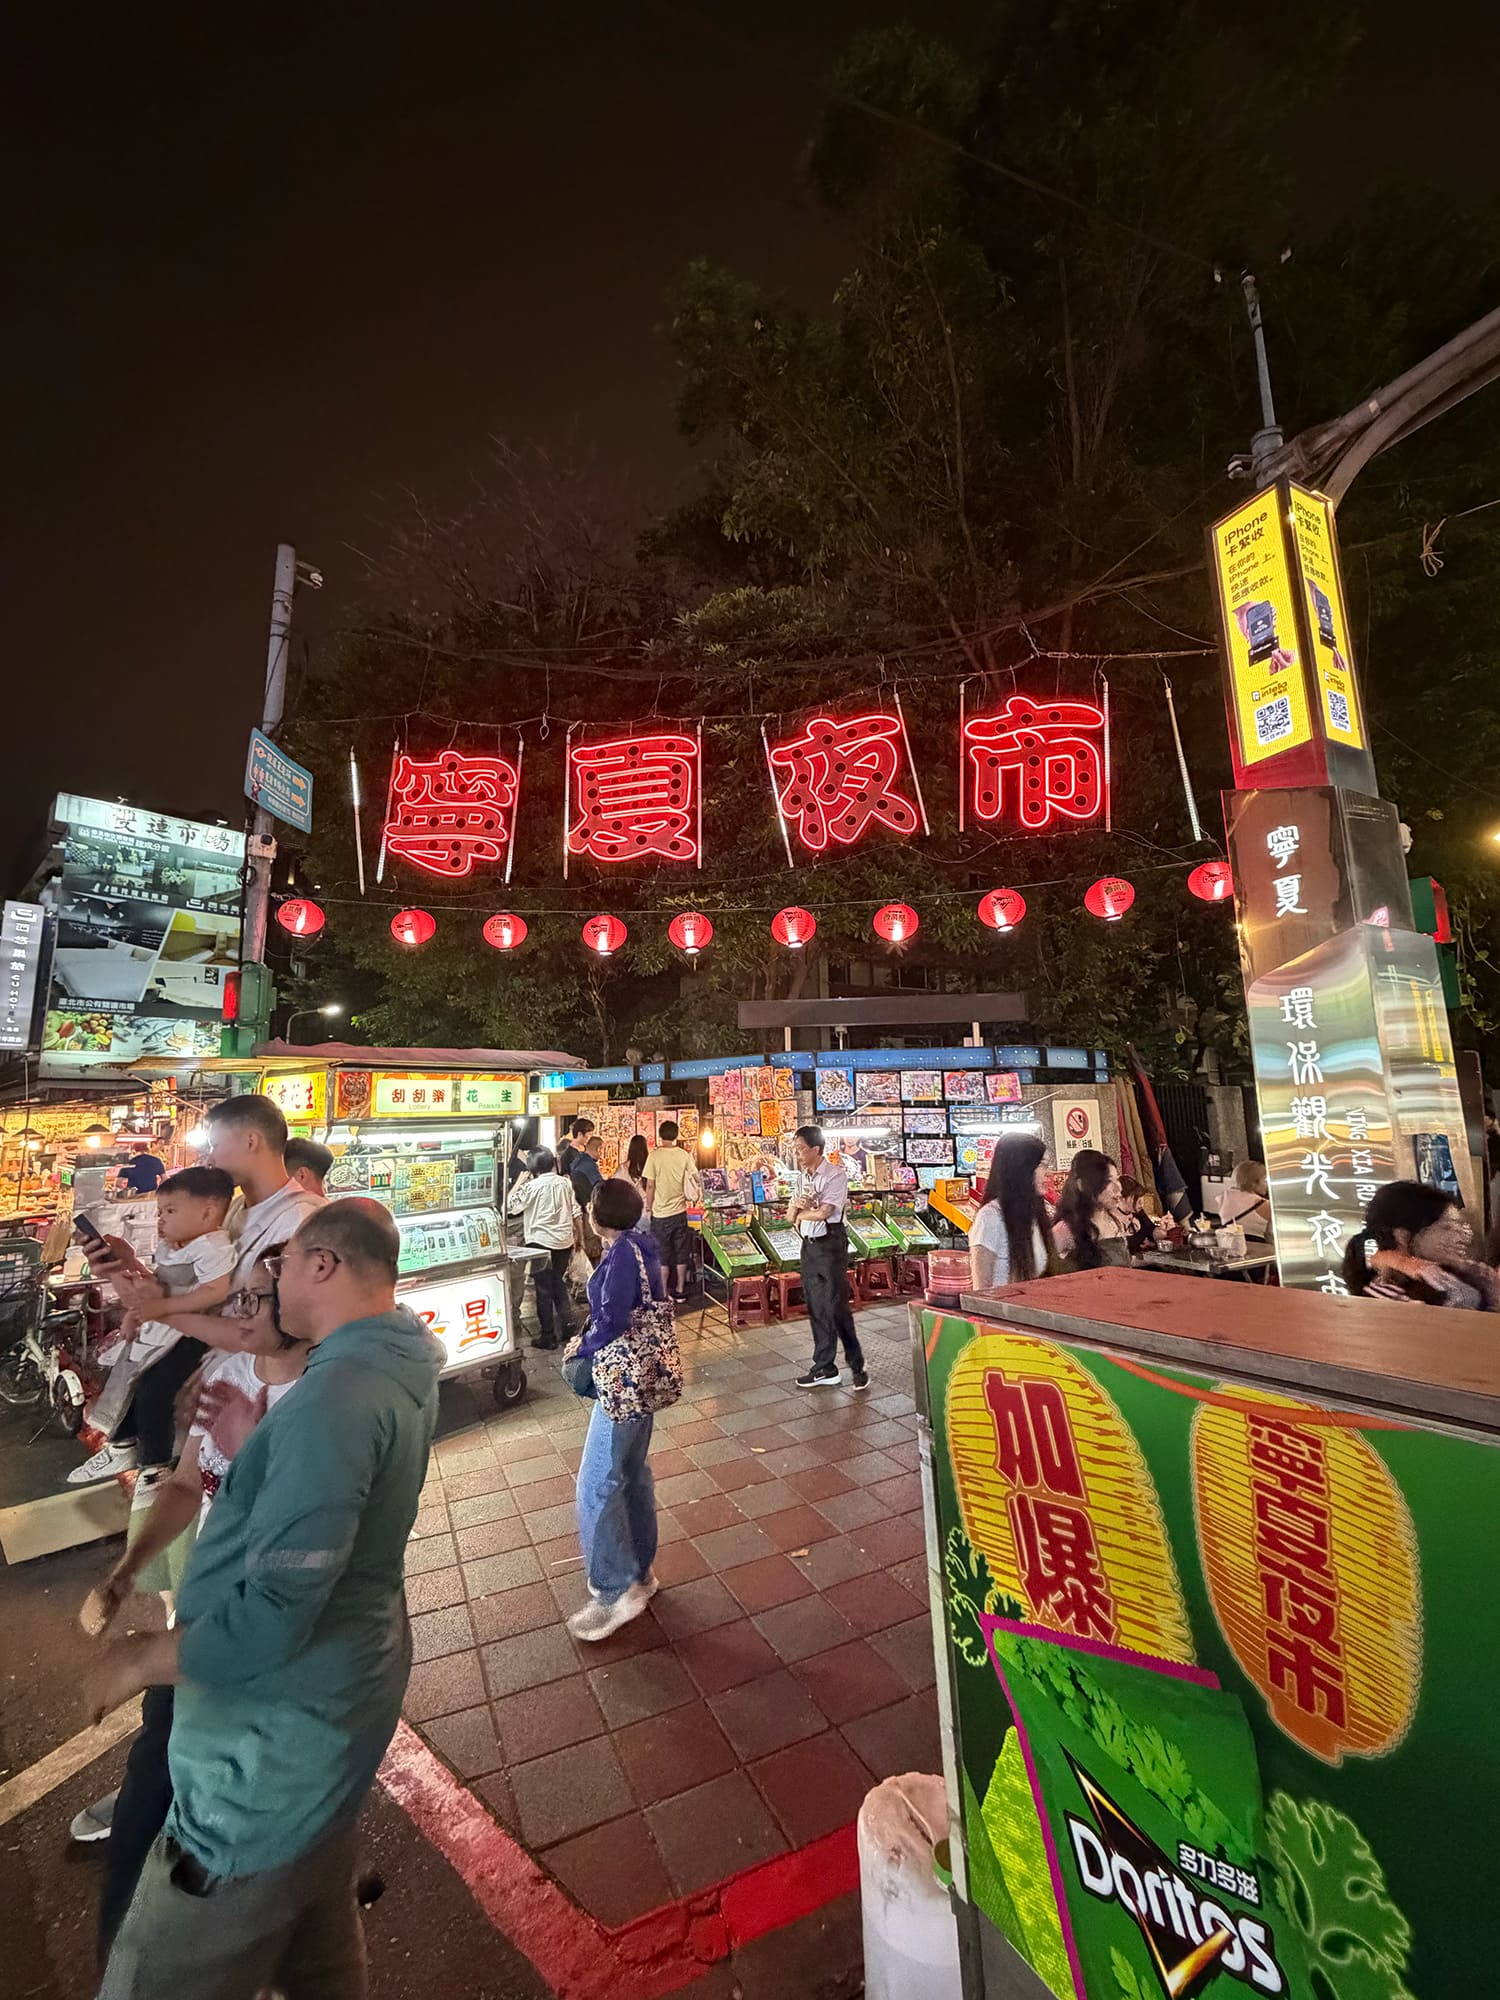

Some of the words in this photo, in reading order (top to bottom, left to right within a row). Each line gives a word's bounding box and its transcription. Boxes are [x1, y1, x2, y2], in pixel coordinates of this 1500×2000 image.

[1224, 511, 1268, 546] iPhone
[1226, 527, 1265, 557] 卡緊收
[1229, 561, 1260, 584] iPhone
[384, 696, 1104, 878] 寧夏夜市
[112, 808, 232, 852] 雙連市場
[1266, 825, 1308, 918] 寧夏
[466, 1088, 513, 1104] 花生
[1350, 1148, 1374, 1175] XIA
[1178, 1842, 1260, 1906] 多力多滋
[1068, 1817, 1283, 1994] Doritos
